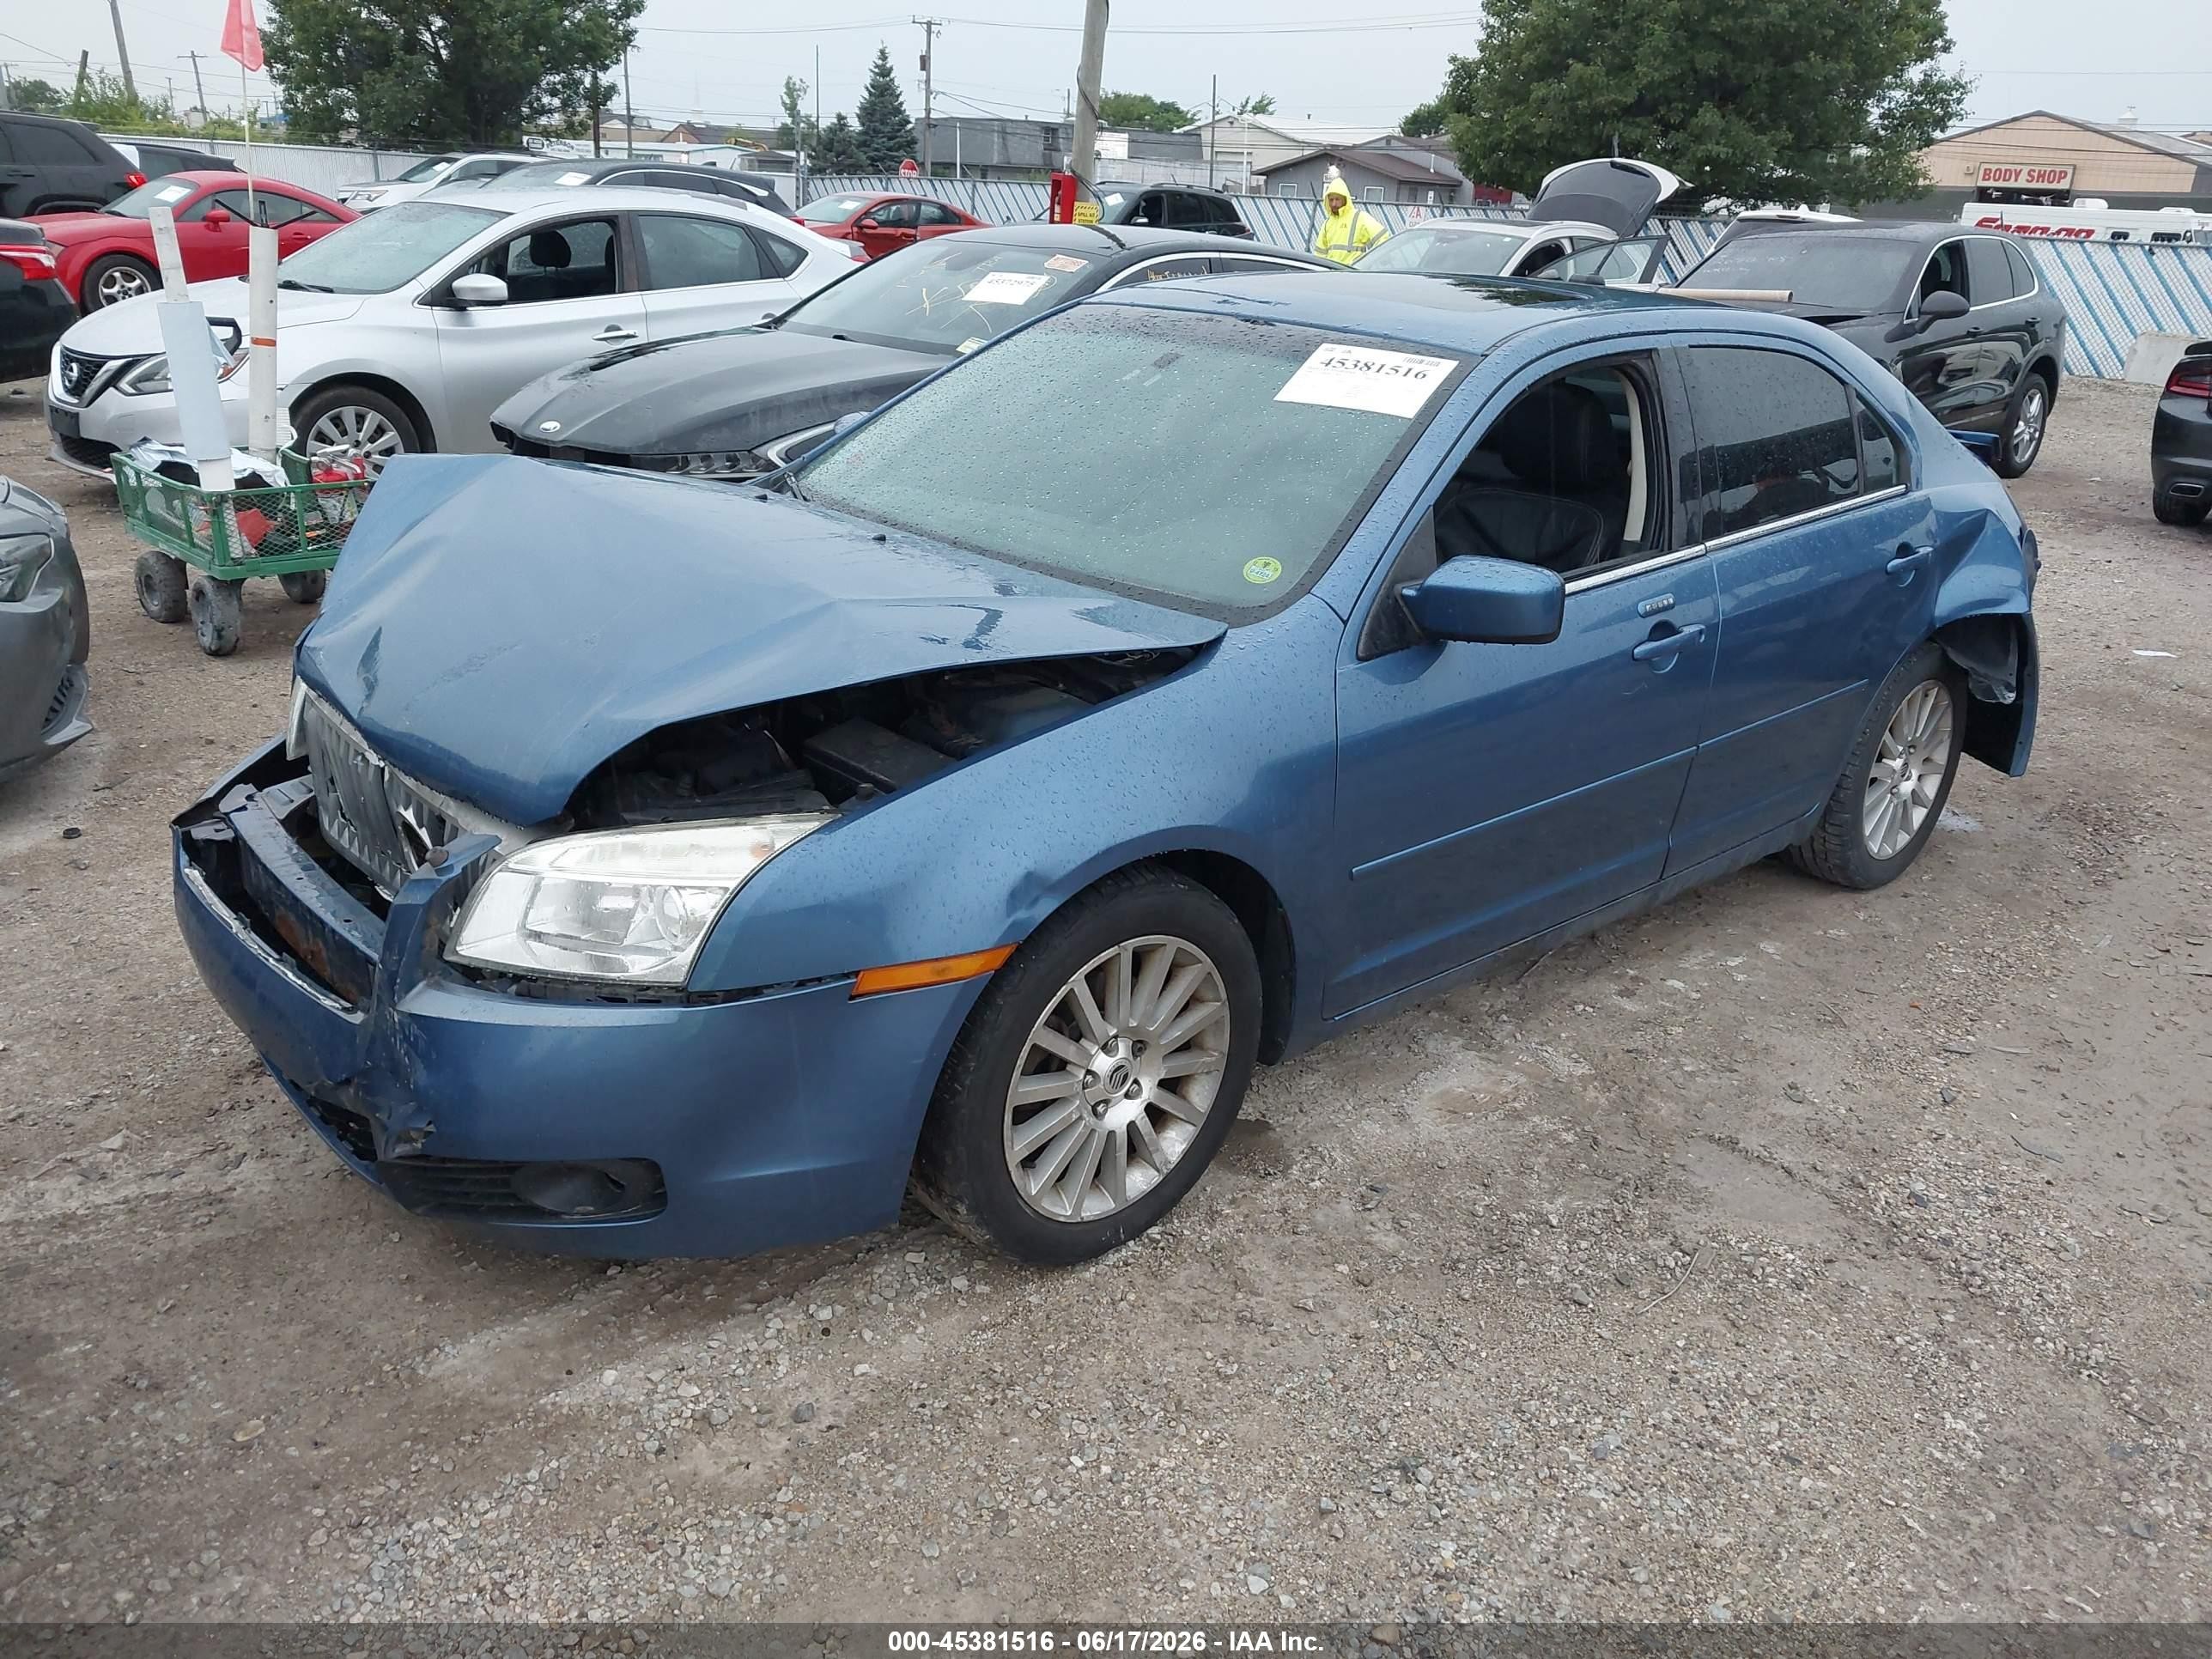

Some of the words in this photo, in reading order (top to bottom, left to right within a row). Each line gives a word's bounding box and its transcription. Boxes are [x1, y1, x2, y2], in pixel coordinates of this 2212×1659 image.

[1981, 167, 2024, 183] BODY
[2025, 168, 2069, 185] SHOP
[1320, 356, 1431, 380] 45381516
